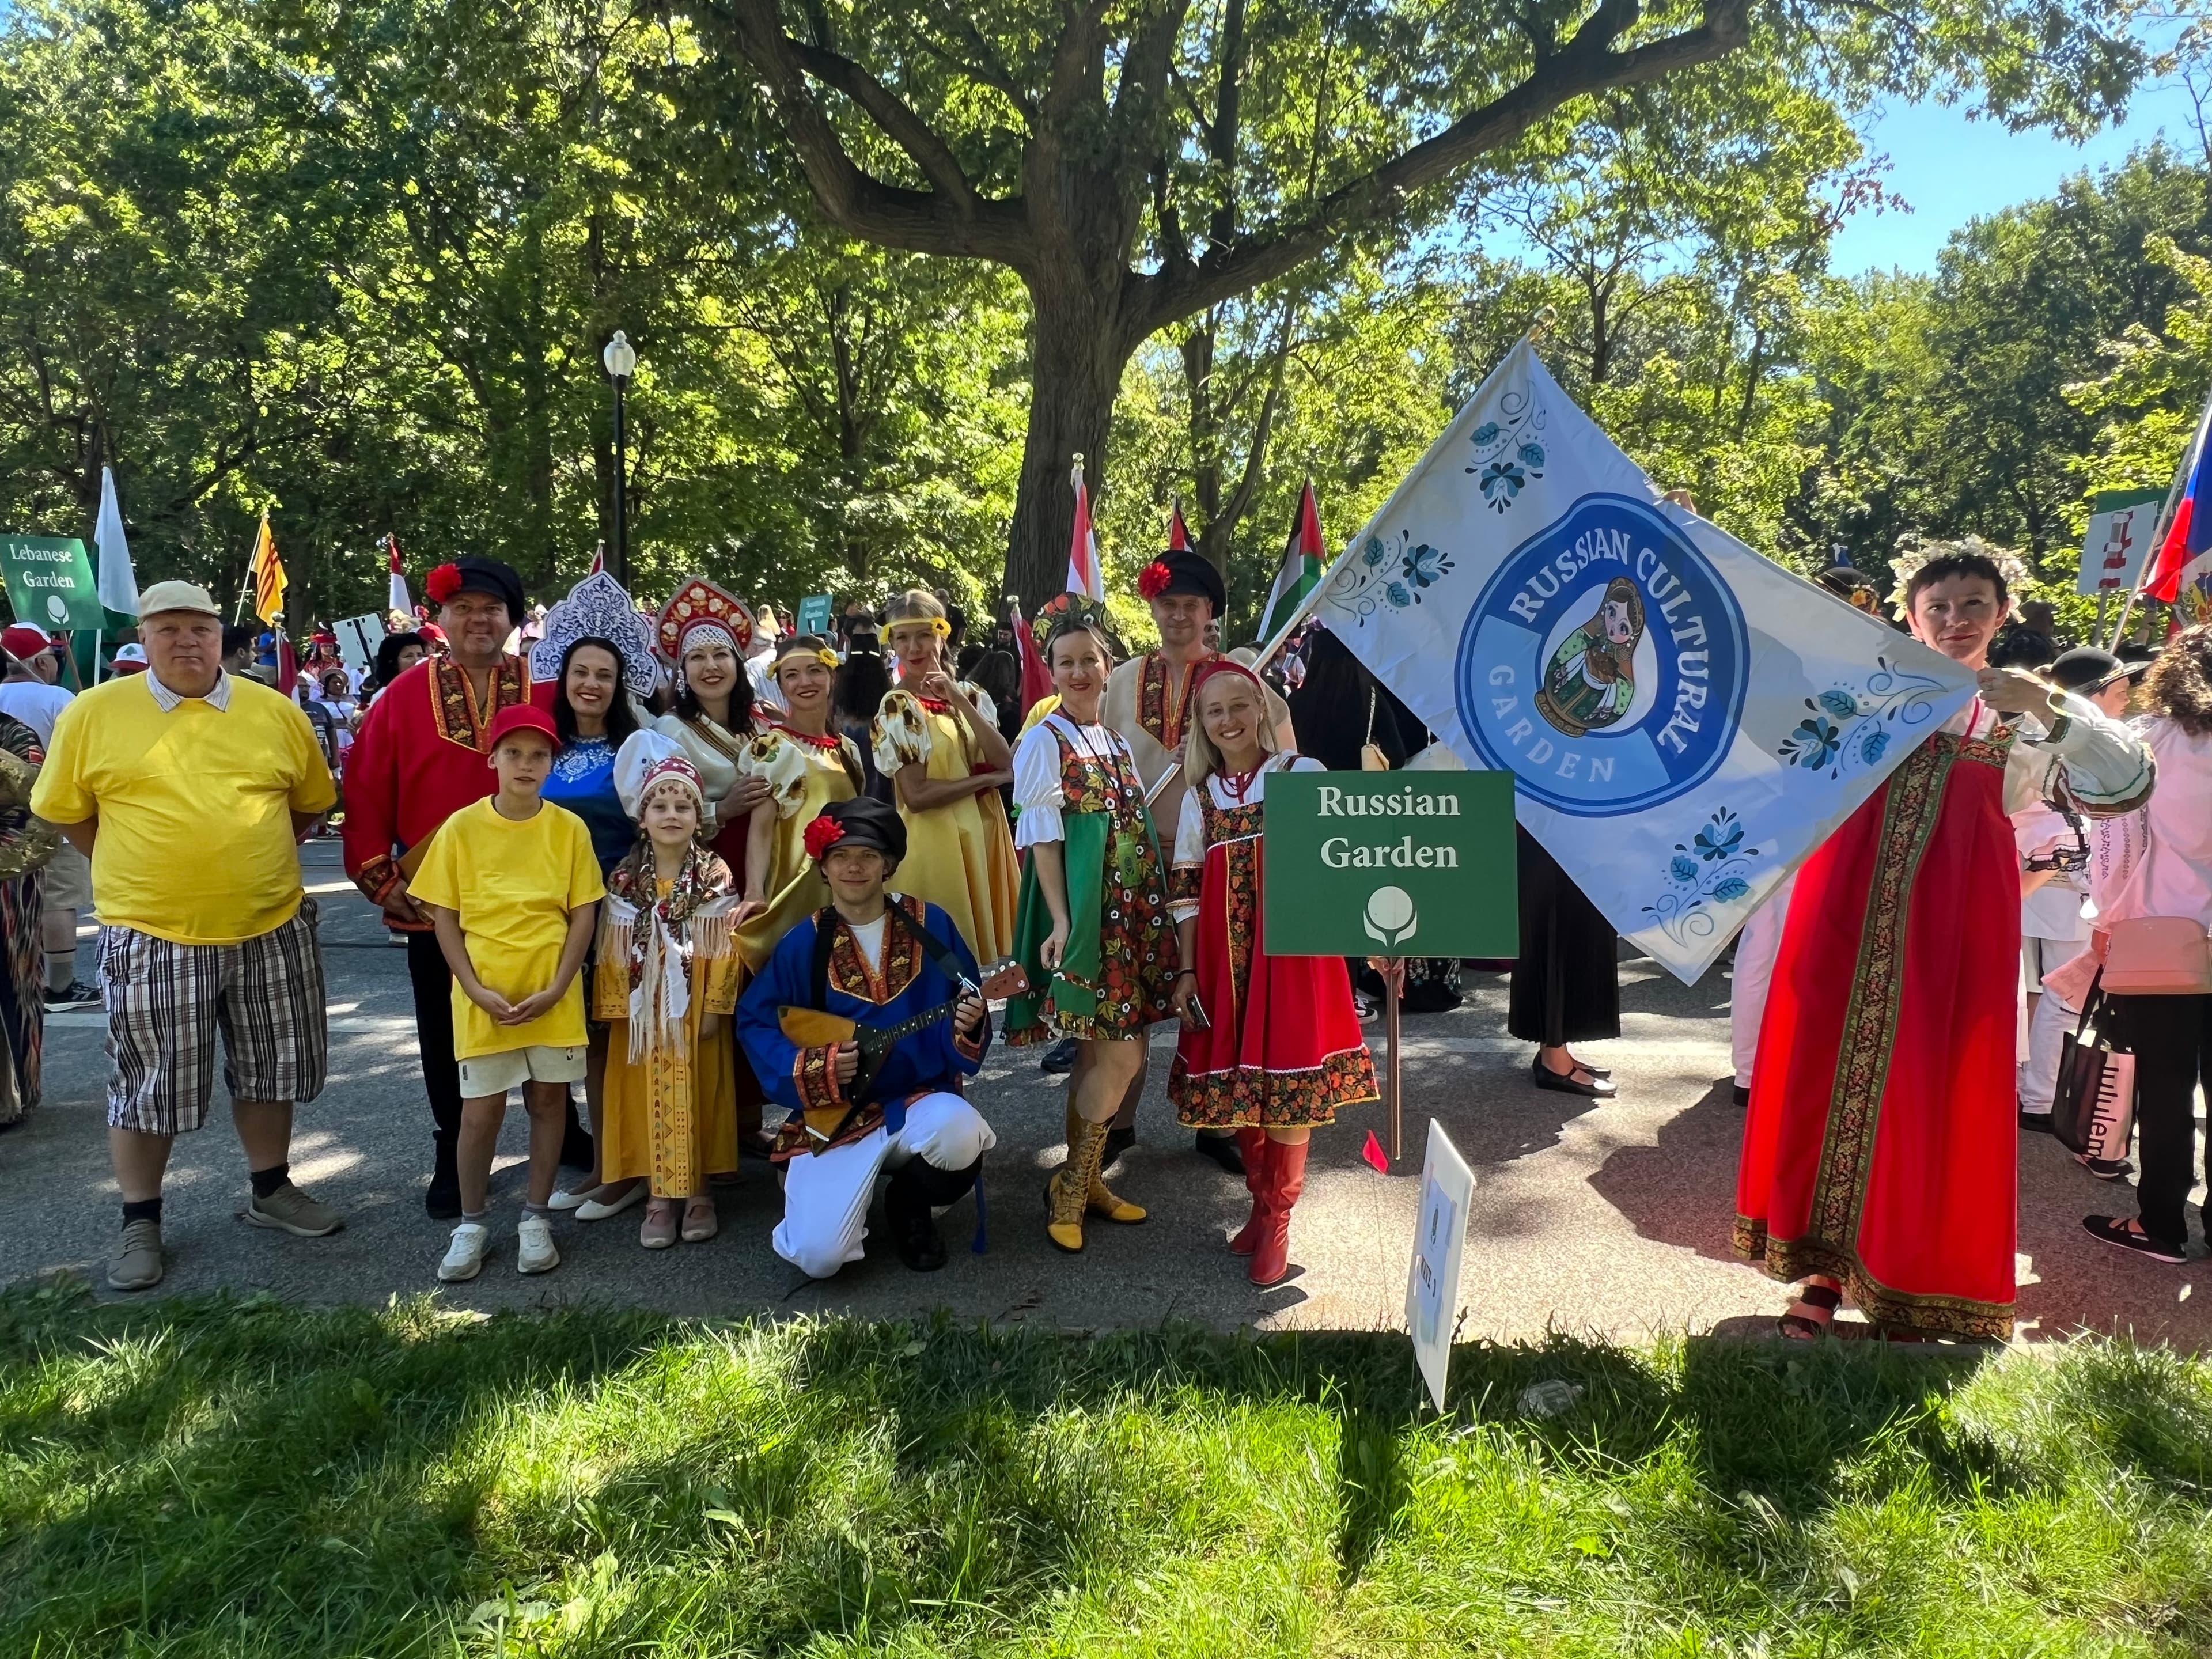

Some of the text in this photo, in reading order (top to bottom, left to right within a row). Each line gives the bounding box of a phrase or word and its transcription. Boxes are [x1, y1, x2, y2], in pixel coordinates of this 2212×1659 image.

[9, 544, 73, 562] Lebanese
[23, 571, 75, 588] Garden
[1508, 528, 1709, 753] RUSSIAN CULTURAL
[1489, 665, 1615, 782] GARDEN
[1317, 786, 1461, 817] Russian
[1320, 836, 1459, 868] Garden
